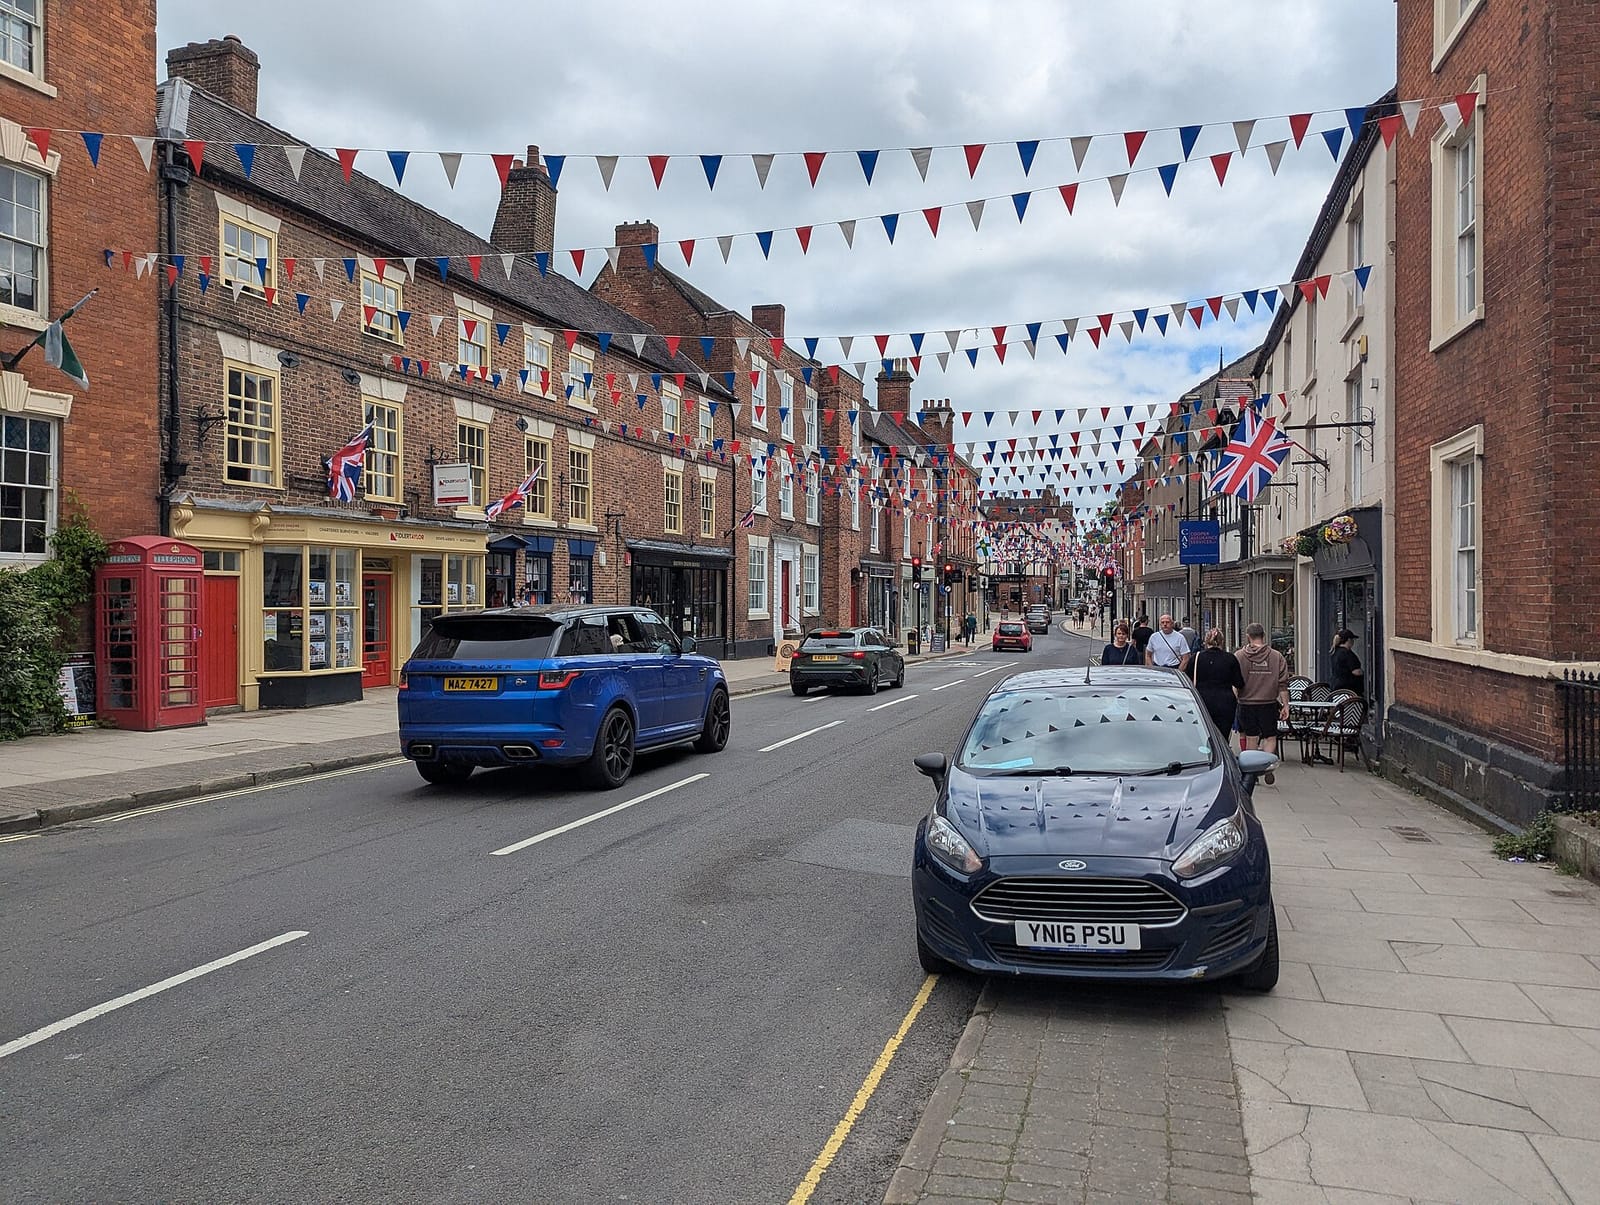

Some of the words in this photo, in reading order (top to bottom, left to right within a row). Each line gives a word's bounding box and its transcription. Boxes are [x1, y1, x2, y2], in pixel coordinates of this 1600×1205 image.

[448, 680, 466, 690] MAZ
[469, 679, 493, 689] 7427
[1028, 923, 1076, 944] YN16
[1082, 925, 1125, 945] PSU
